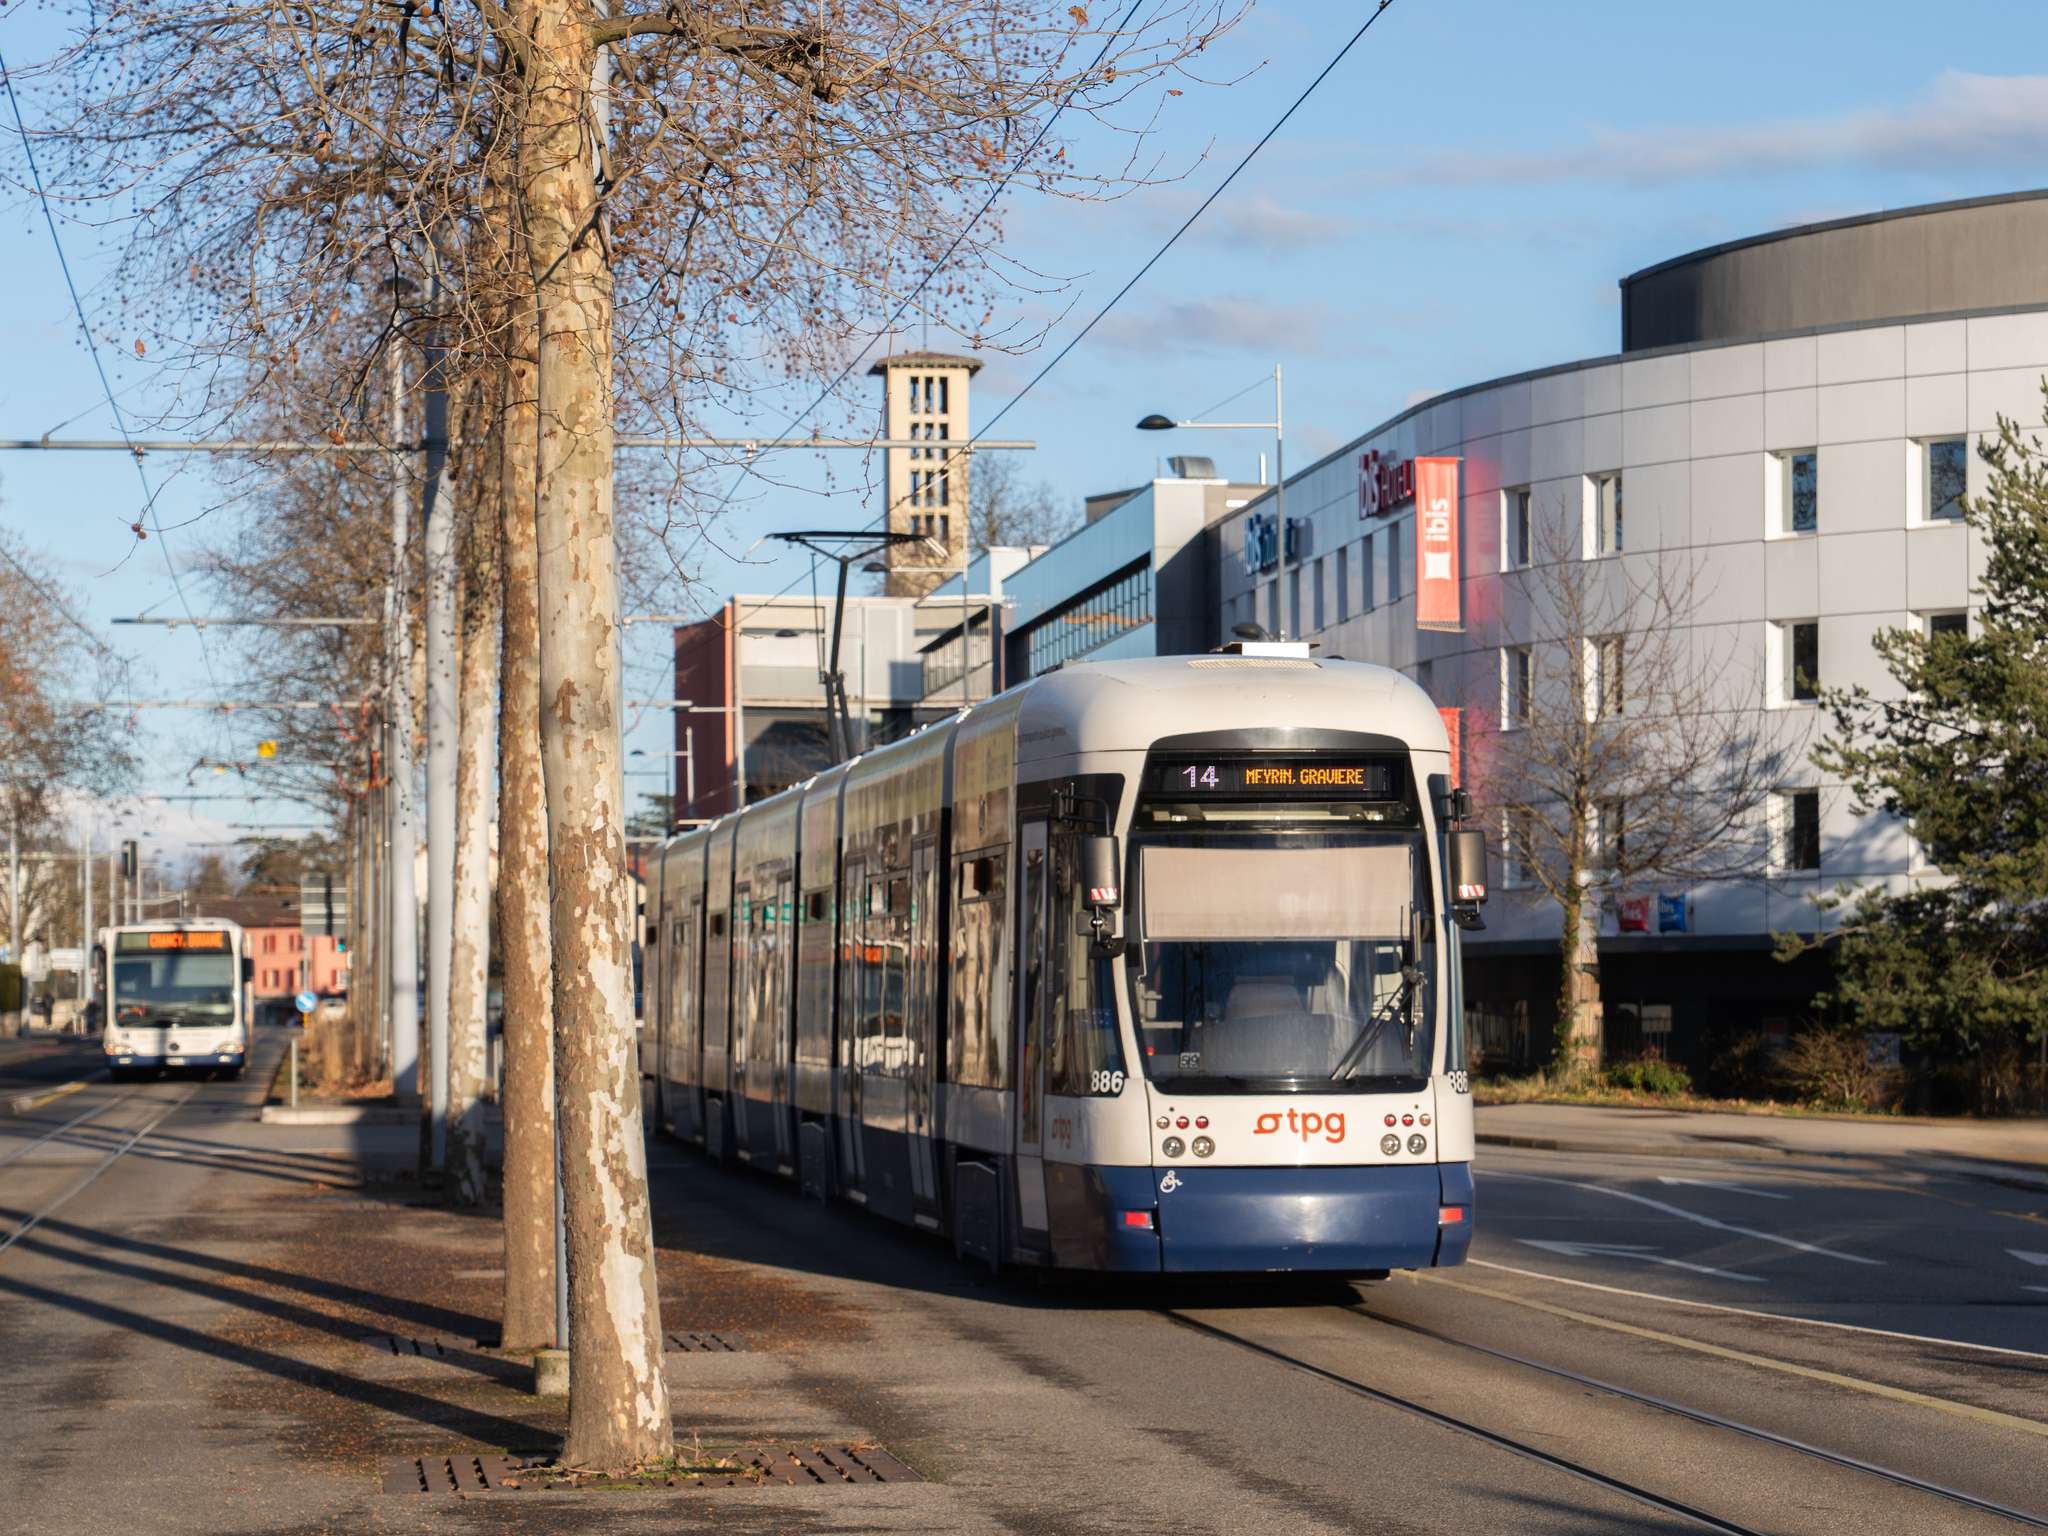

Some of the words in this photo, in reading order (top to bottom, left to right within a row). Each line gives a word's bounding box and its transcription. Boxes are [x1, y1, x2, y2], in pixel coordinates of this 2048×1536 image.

[1425, 497, 1450, 541] ibis
[1181, 765, 1220, 790] 14
[1300, 768, 1365, 785] GRAVIERE
[1091, 1070, 1124, 1093] 886
